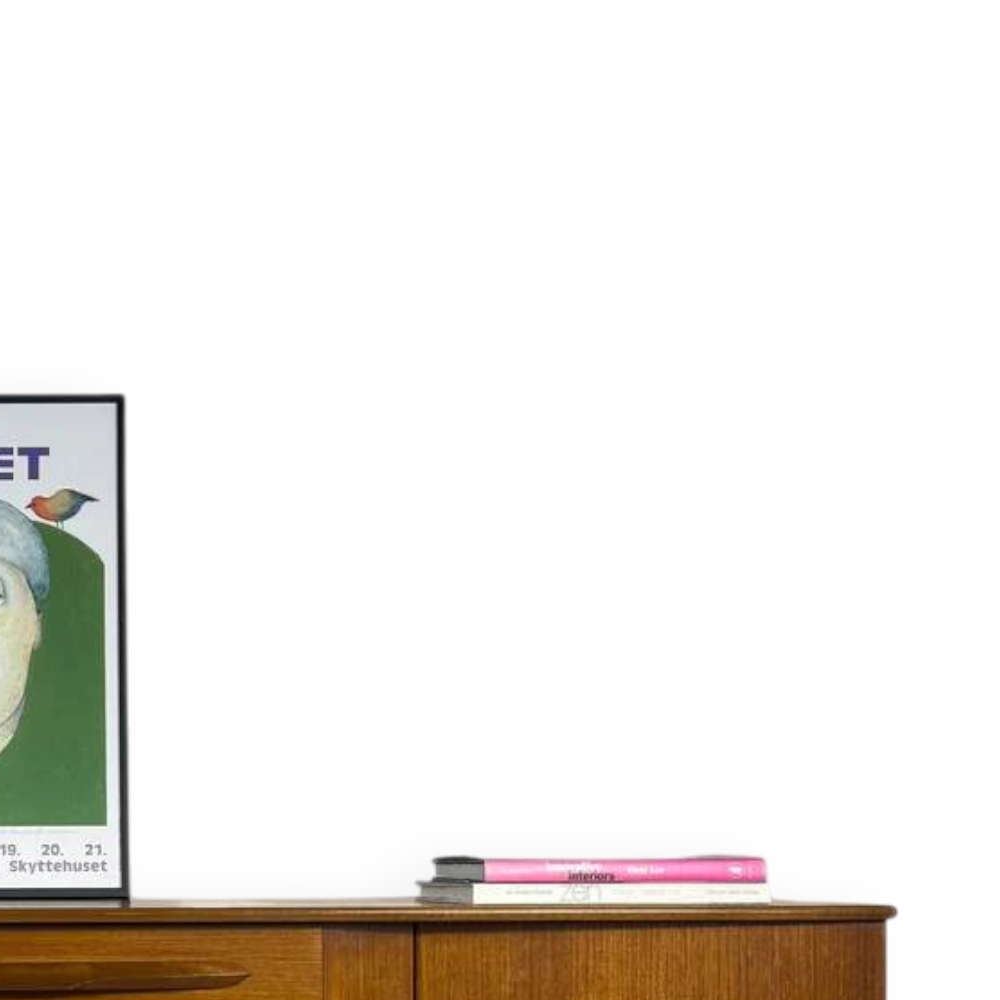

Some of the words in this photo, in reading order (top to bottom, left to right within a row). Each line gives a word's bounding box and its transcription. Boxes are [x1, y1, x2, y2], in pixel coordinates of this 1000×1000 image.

[0, 844, 21, 856] 19.
[41, 844, 64, 856] 20.
[85, 844, 107, 856] 21.
[9, 860, 108, 874] Skyttehuset
[568, 870, 615, 882] interiors
